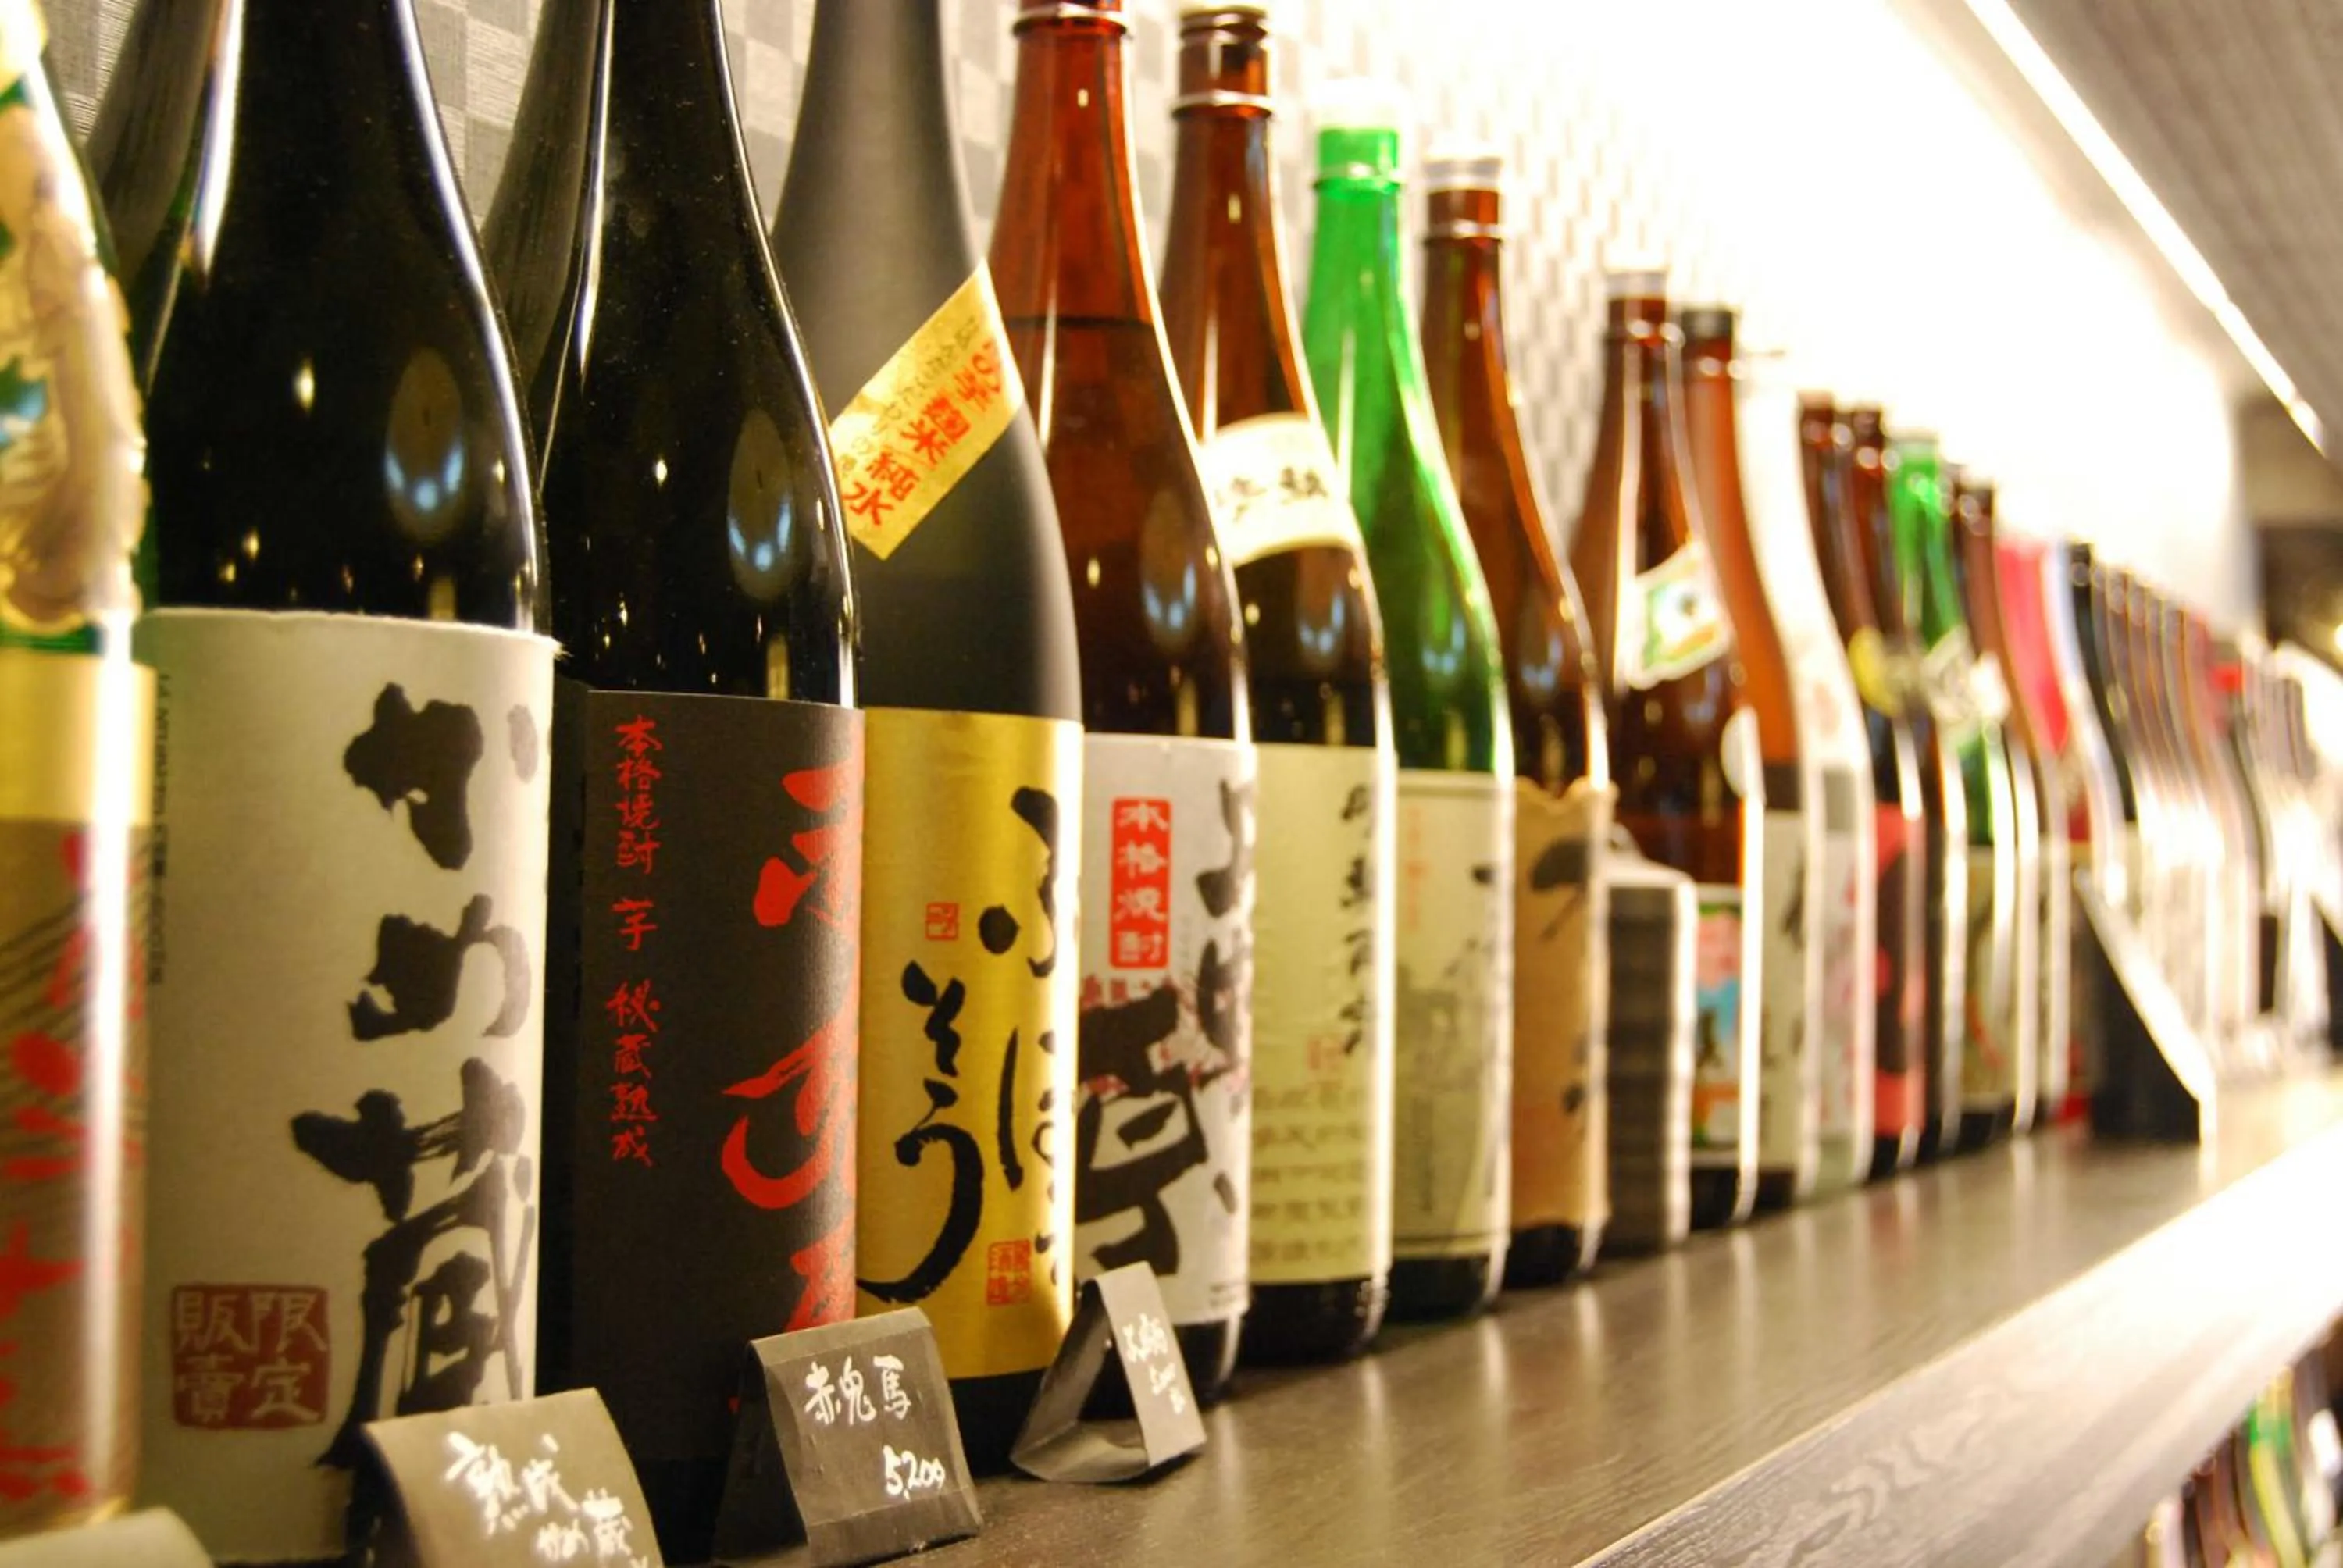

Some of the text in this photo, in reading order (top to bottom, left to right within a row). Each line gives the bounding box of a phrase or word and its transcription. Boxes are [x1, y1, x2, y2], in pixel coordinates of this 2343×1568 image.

[615, 714, 662, 875] 本格焼酎
[612, 898, 658, 950] 芋
[1114, 802, 1170, 964] 本格焼酎
